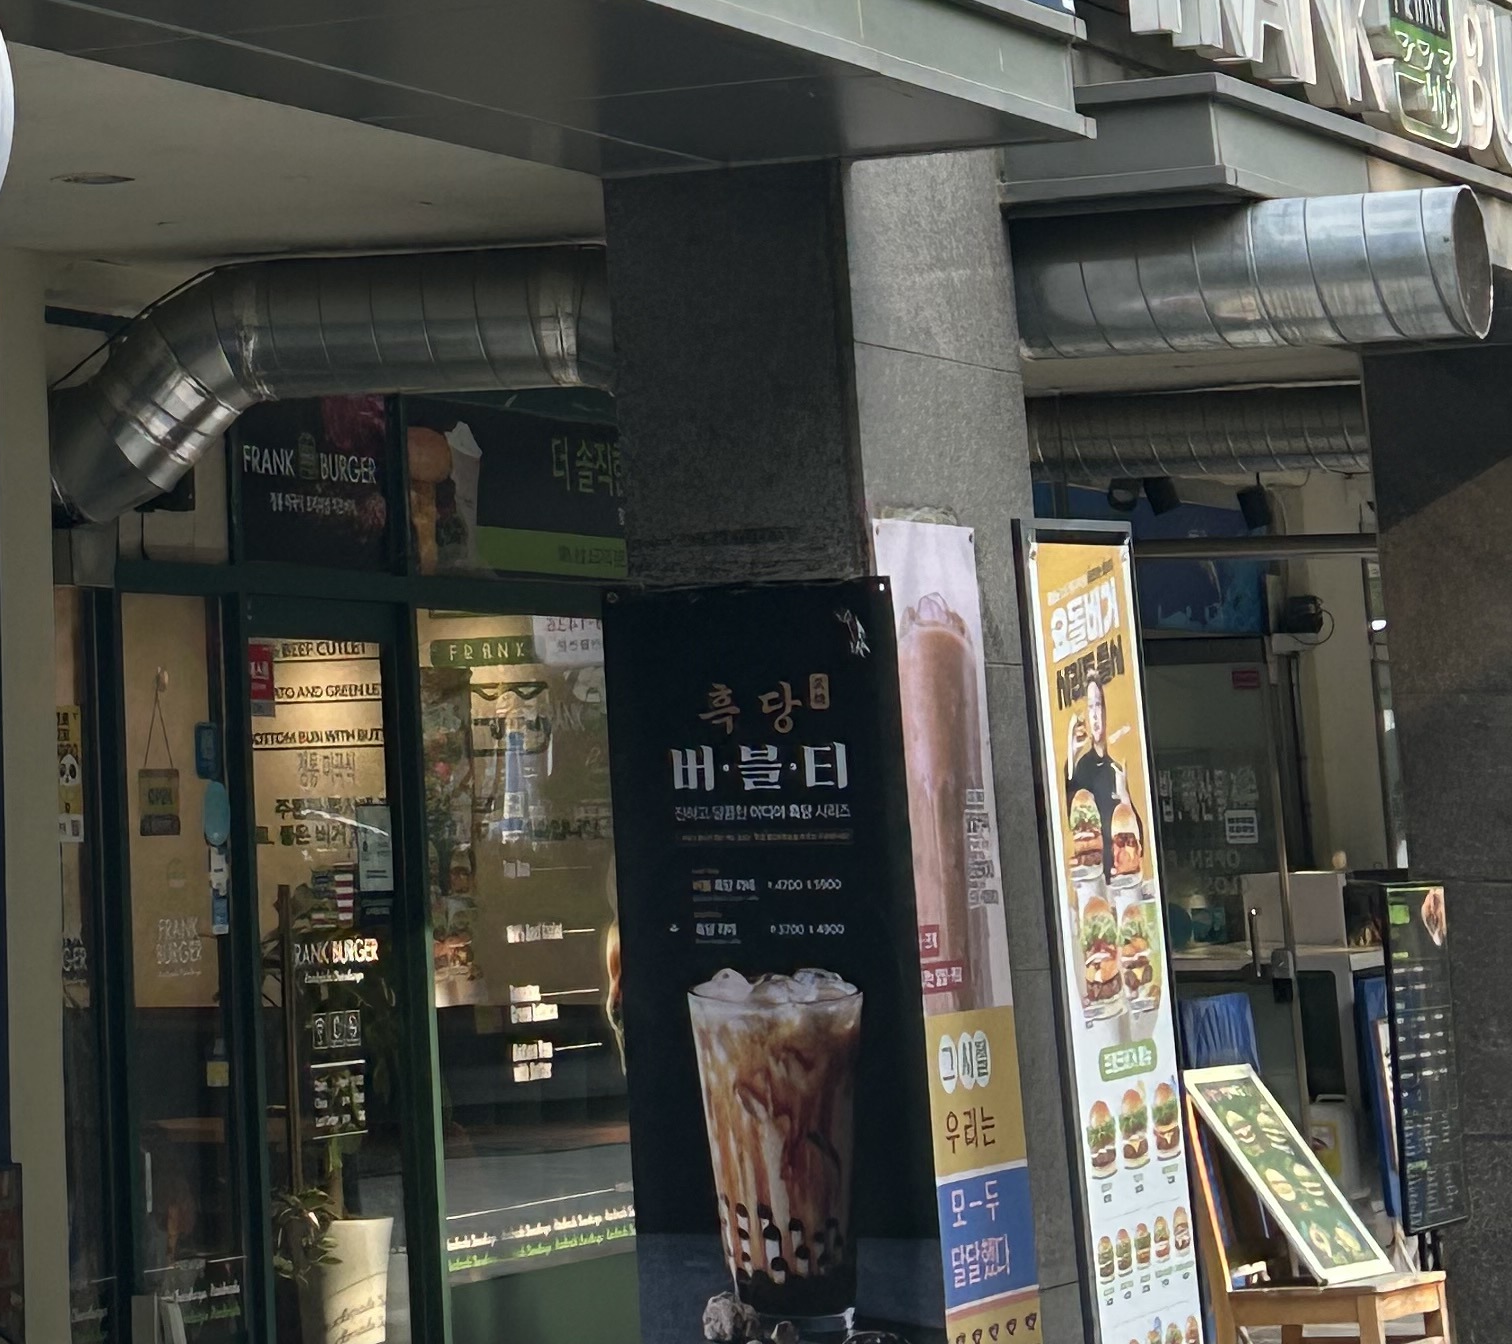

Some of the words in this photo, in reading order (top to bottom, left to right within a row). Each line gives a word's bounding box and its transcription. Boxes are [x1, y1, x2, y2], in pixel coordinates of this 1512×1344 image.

[242, 444, 296, 478] FRANK
[319, 452, 378, 485] BURGER
[551, 436, 571, 492] 더
[297, 685, 323, 698] AND
[252, 732, 296, 746] OTTOM
[294, 943, 329, 965] RANK
[331, 937, 380, 964] BURGER
[945, 1106, 996, 1154] 우리는
